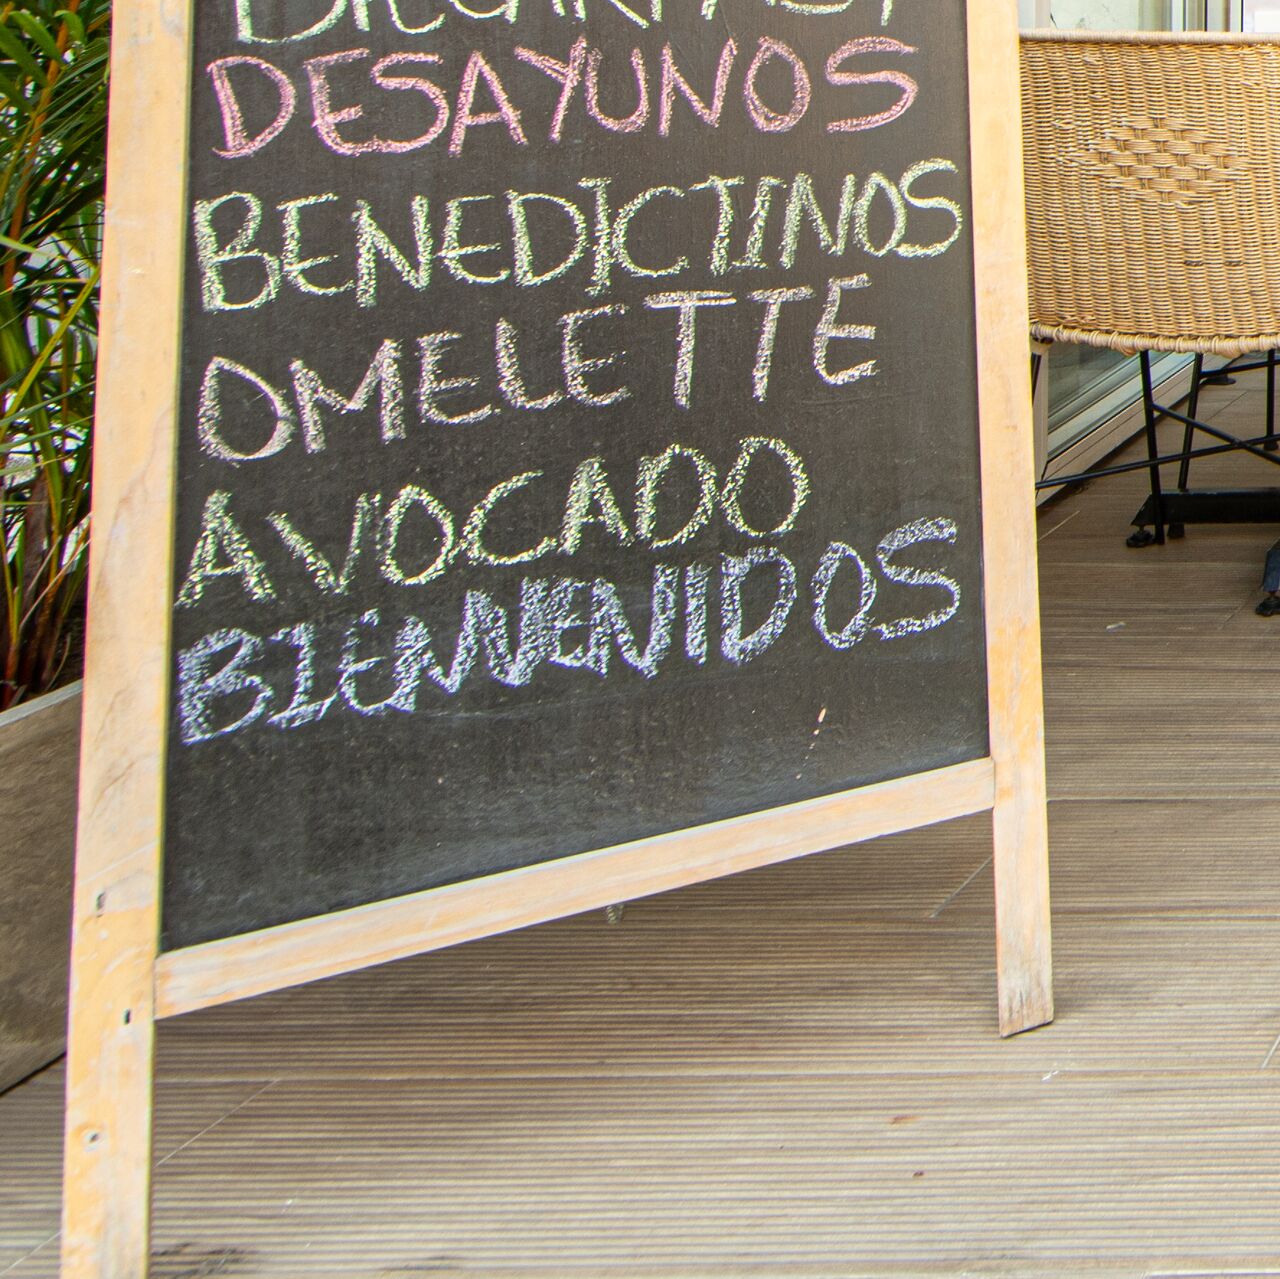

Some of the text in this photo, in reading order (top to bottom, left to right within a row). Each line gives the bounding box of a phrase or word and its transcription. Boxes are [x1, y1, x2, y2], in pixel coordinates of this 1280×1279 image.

[206, 34, 920, 159] DESAYUNOS
[193, 158, 964, 313] BENEDICTINOS
[198, 272, 880, 464] OMELETTE
[174, 435, 810, 608] AVOCADO
[176, 517, 962, 746] BIENVENIDOS
